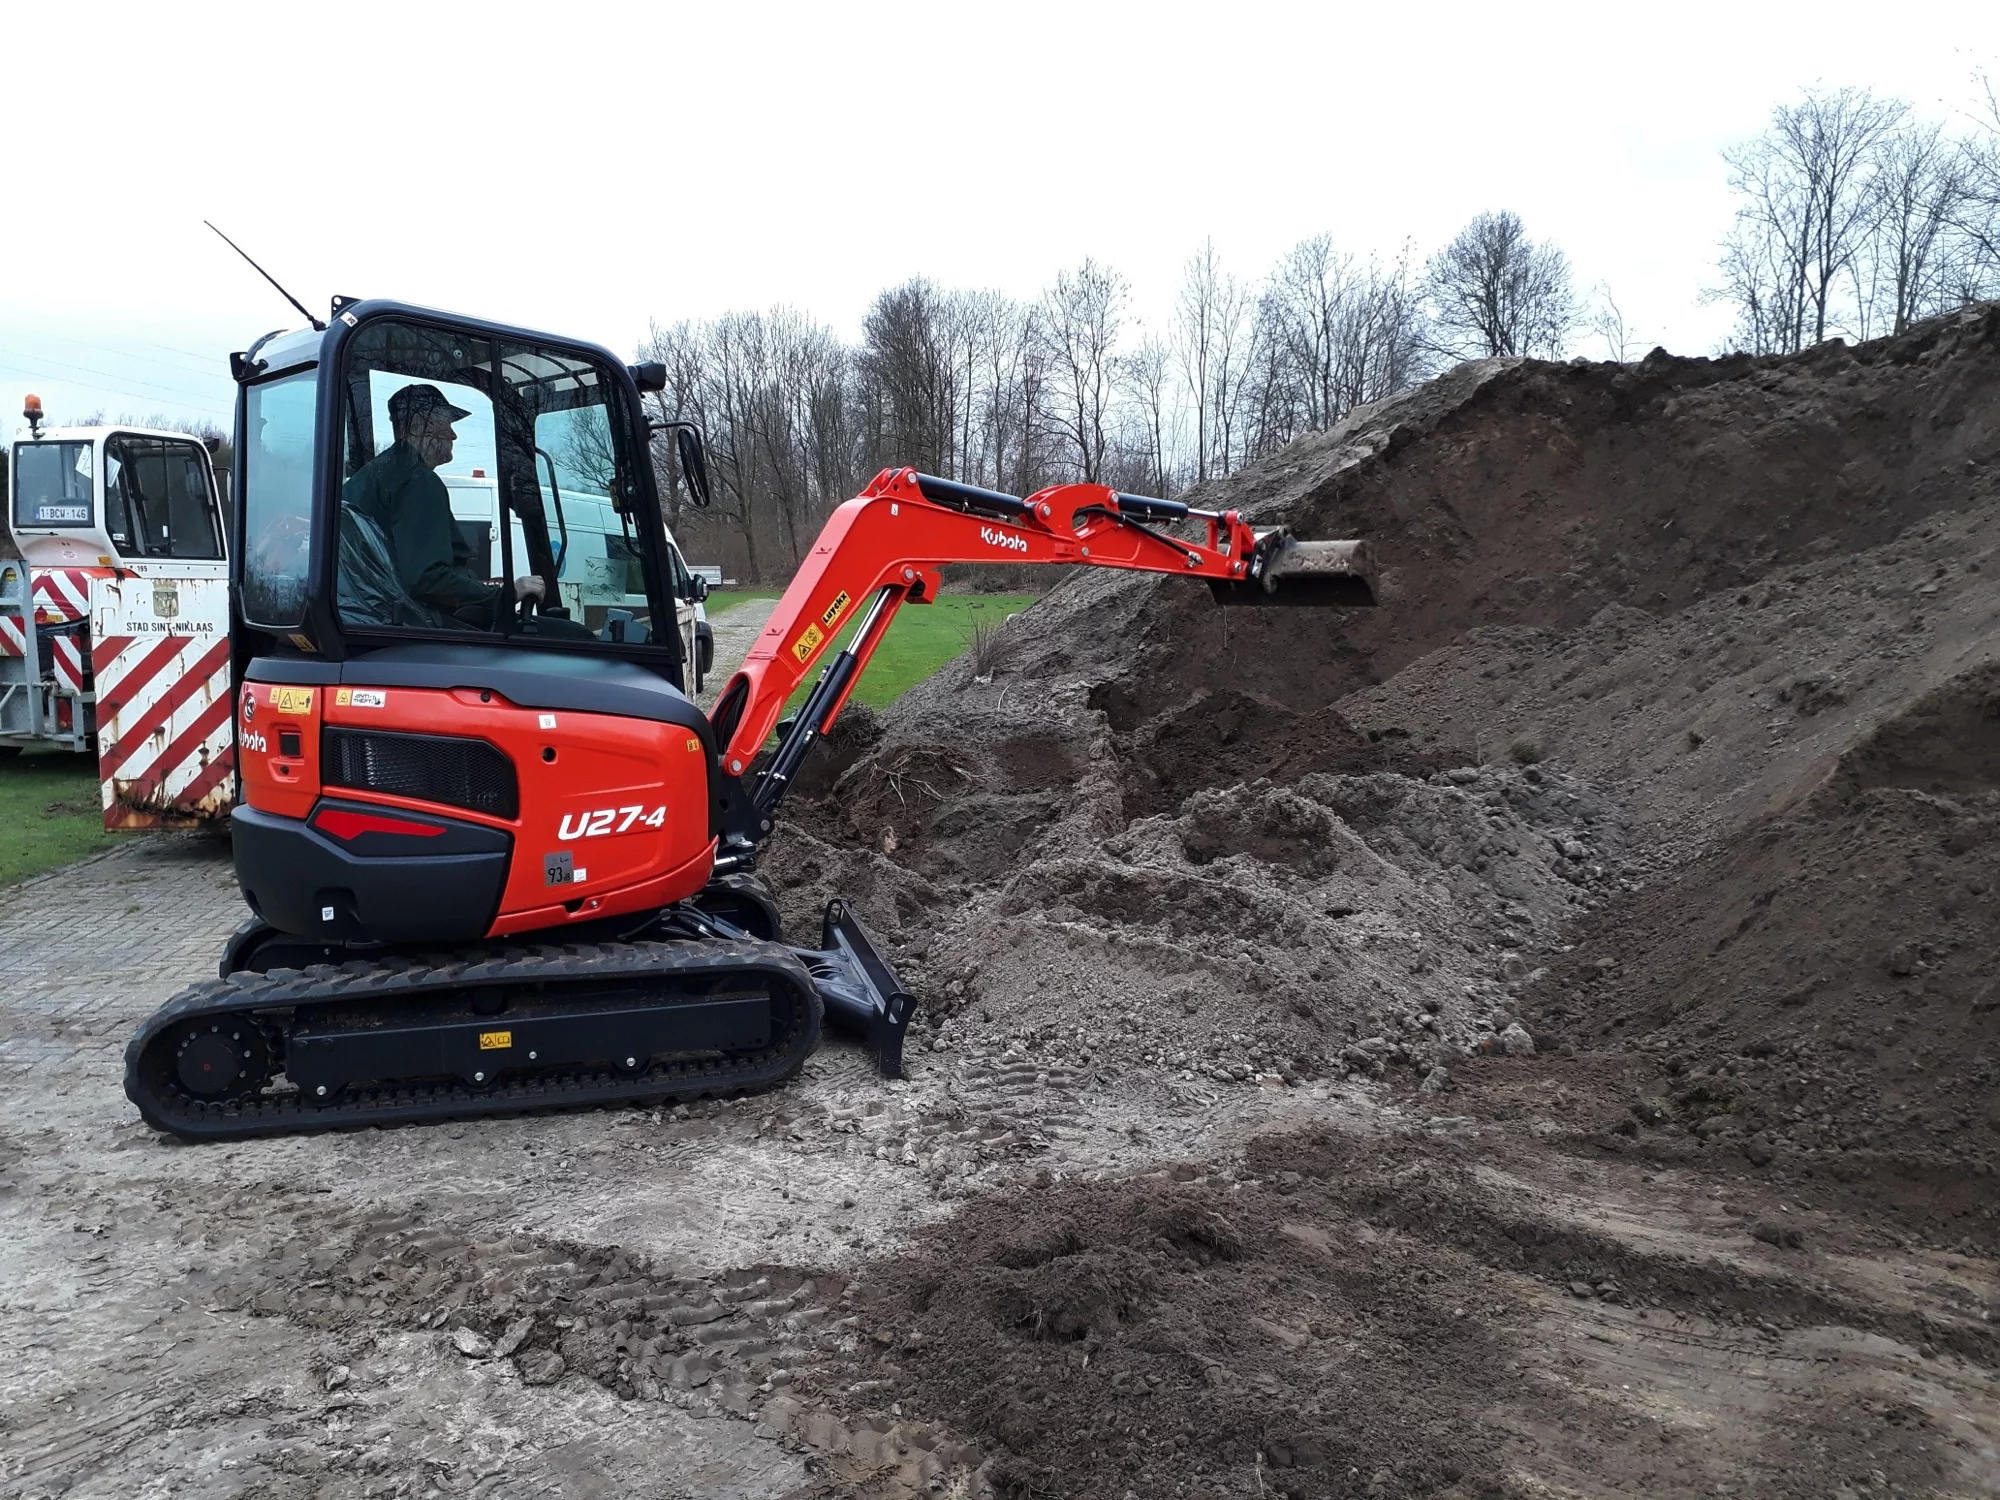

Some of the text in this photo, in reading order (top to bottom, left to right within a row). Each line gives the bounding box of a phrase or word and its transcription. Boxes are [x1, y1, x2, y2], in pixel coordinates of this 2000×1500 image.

[981, 526, 1028, 553] Kubota
[126, 622, 149, 632] STAD
[557, 805, 667, 841] U27-4
[547, 866, 564, 884] 93
